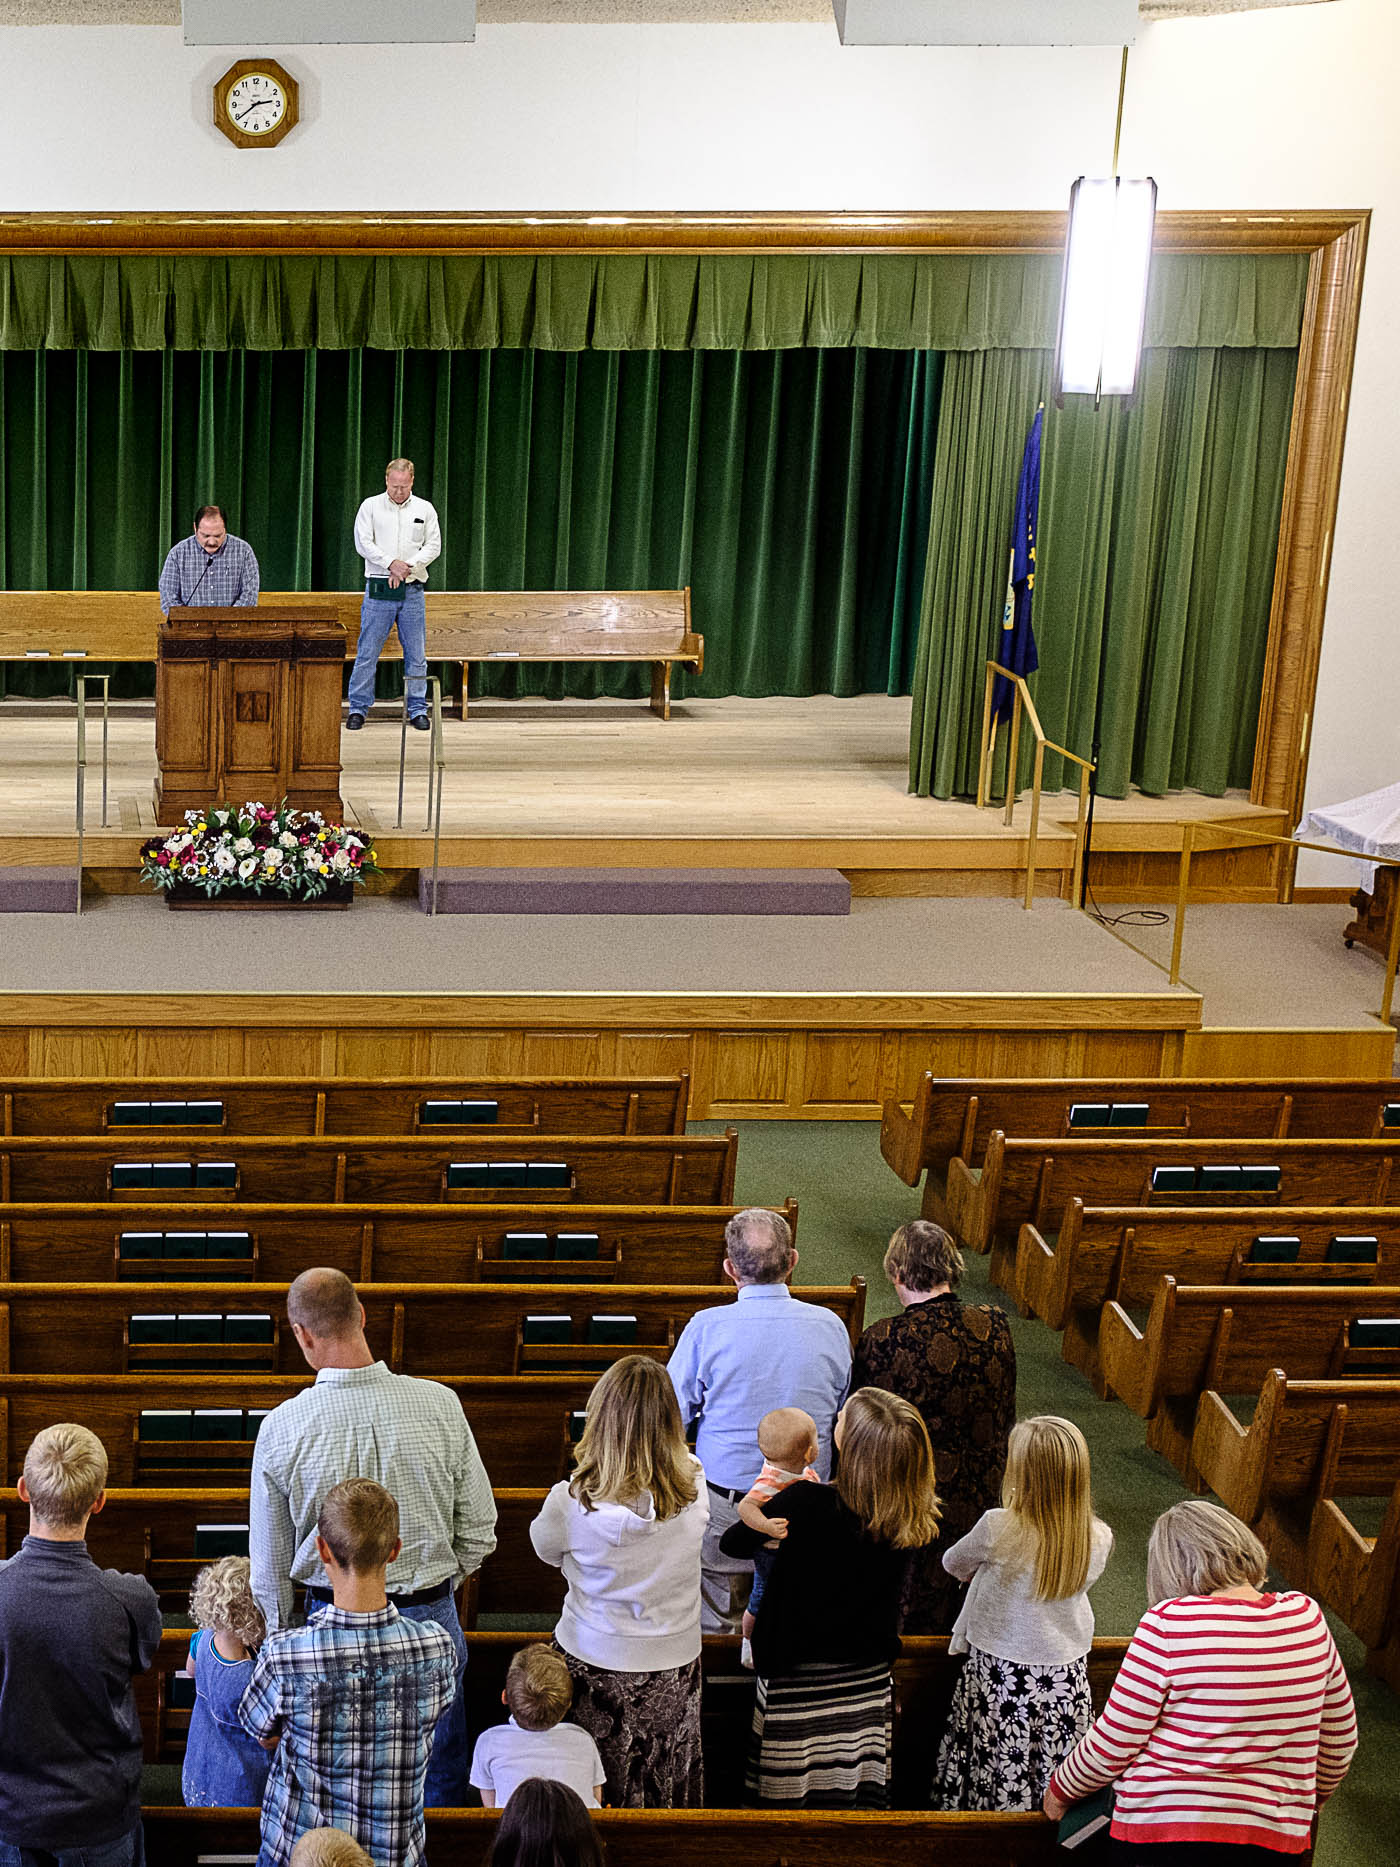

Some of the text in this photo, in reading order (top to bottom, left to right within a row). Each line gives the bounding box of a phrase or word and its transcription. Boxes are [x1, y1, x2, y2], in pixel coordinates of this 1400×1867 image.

[252, 77, 260, 85] 12
[272, 88, 278, 96] 2
[253, 123, 259, 131] 6
